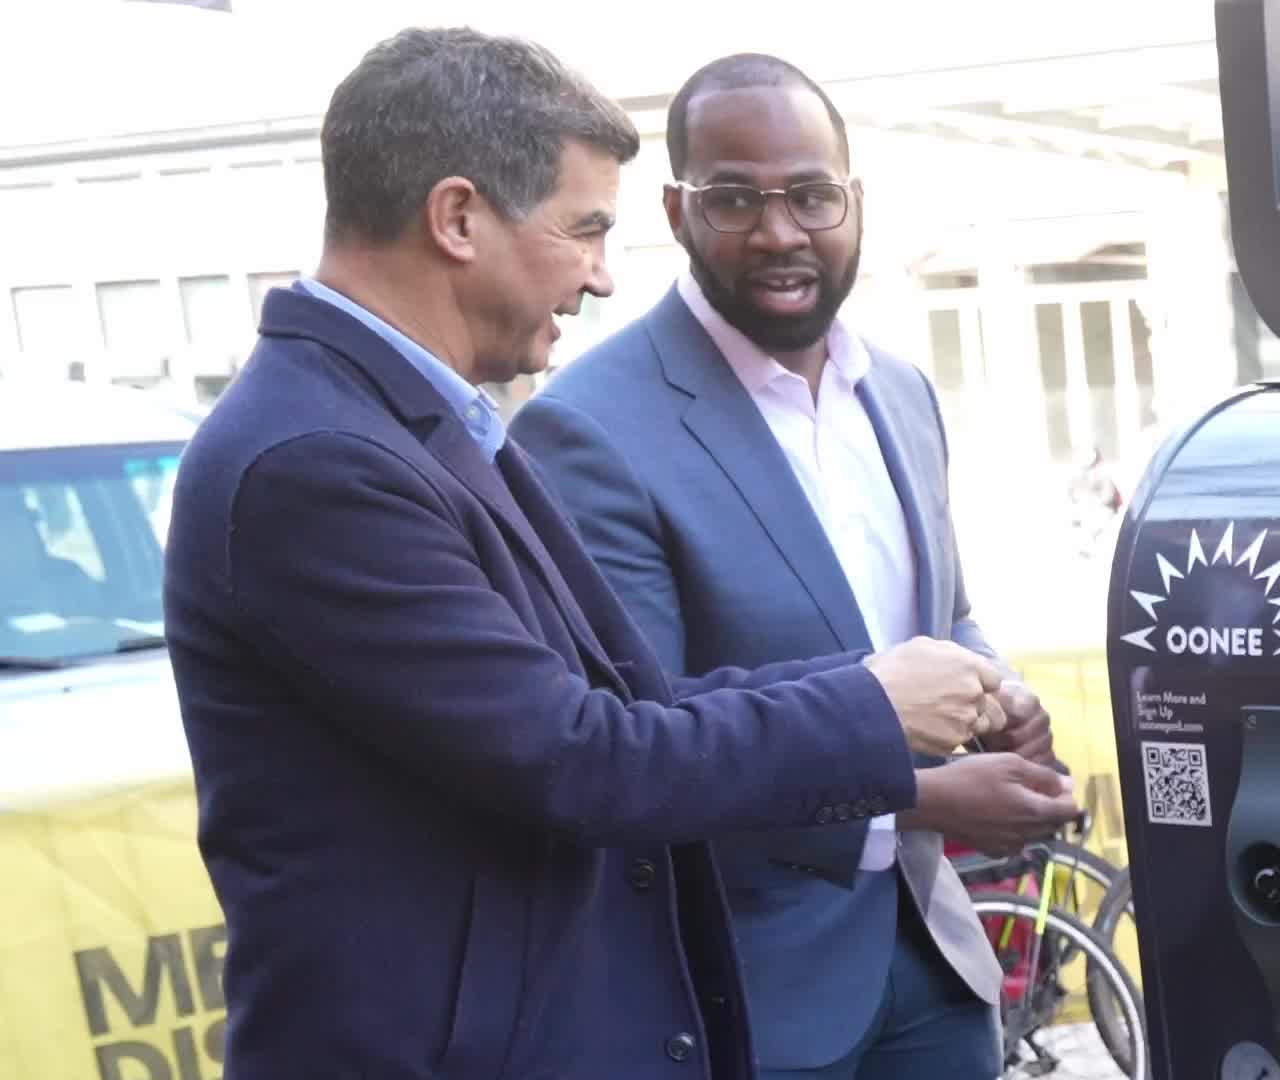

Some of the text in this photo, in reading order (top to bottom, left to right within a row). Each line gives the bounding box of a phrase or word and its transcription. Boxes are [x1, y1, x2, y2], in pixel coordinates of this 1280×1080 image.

[1166, 625, 1264, 656] OONEE
[1163, 690, 1188, 704] More
[1189, 691, 1206, 705] and
[1159, 704, 1173, 721] Up
